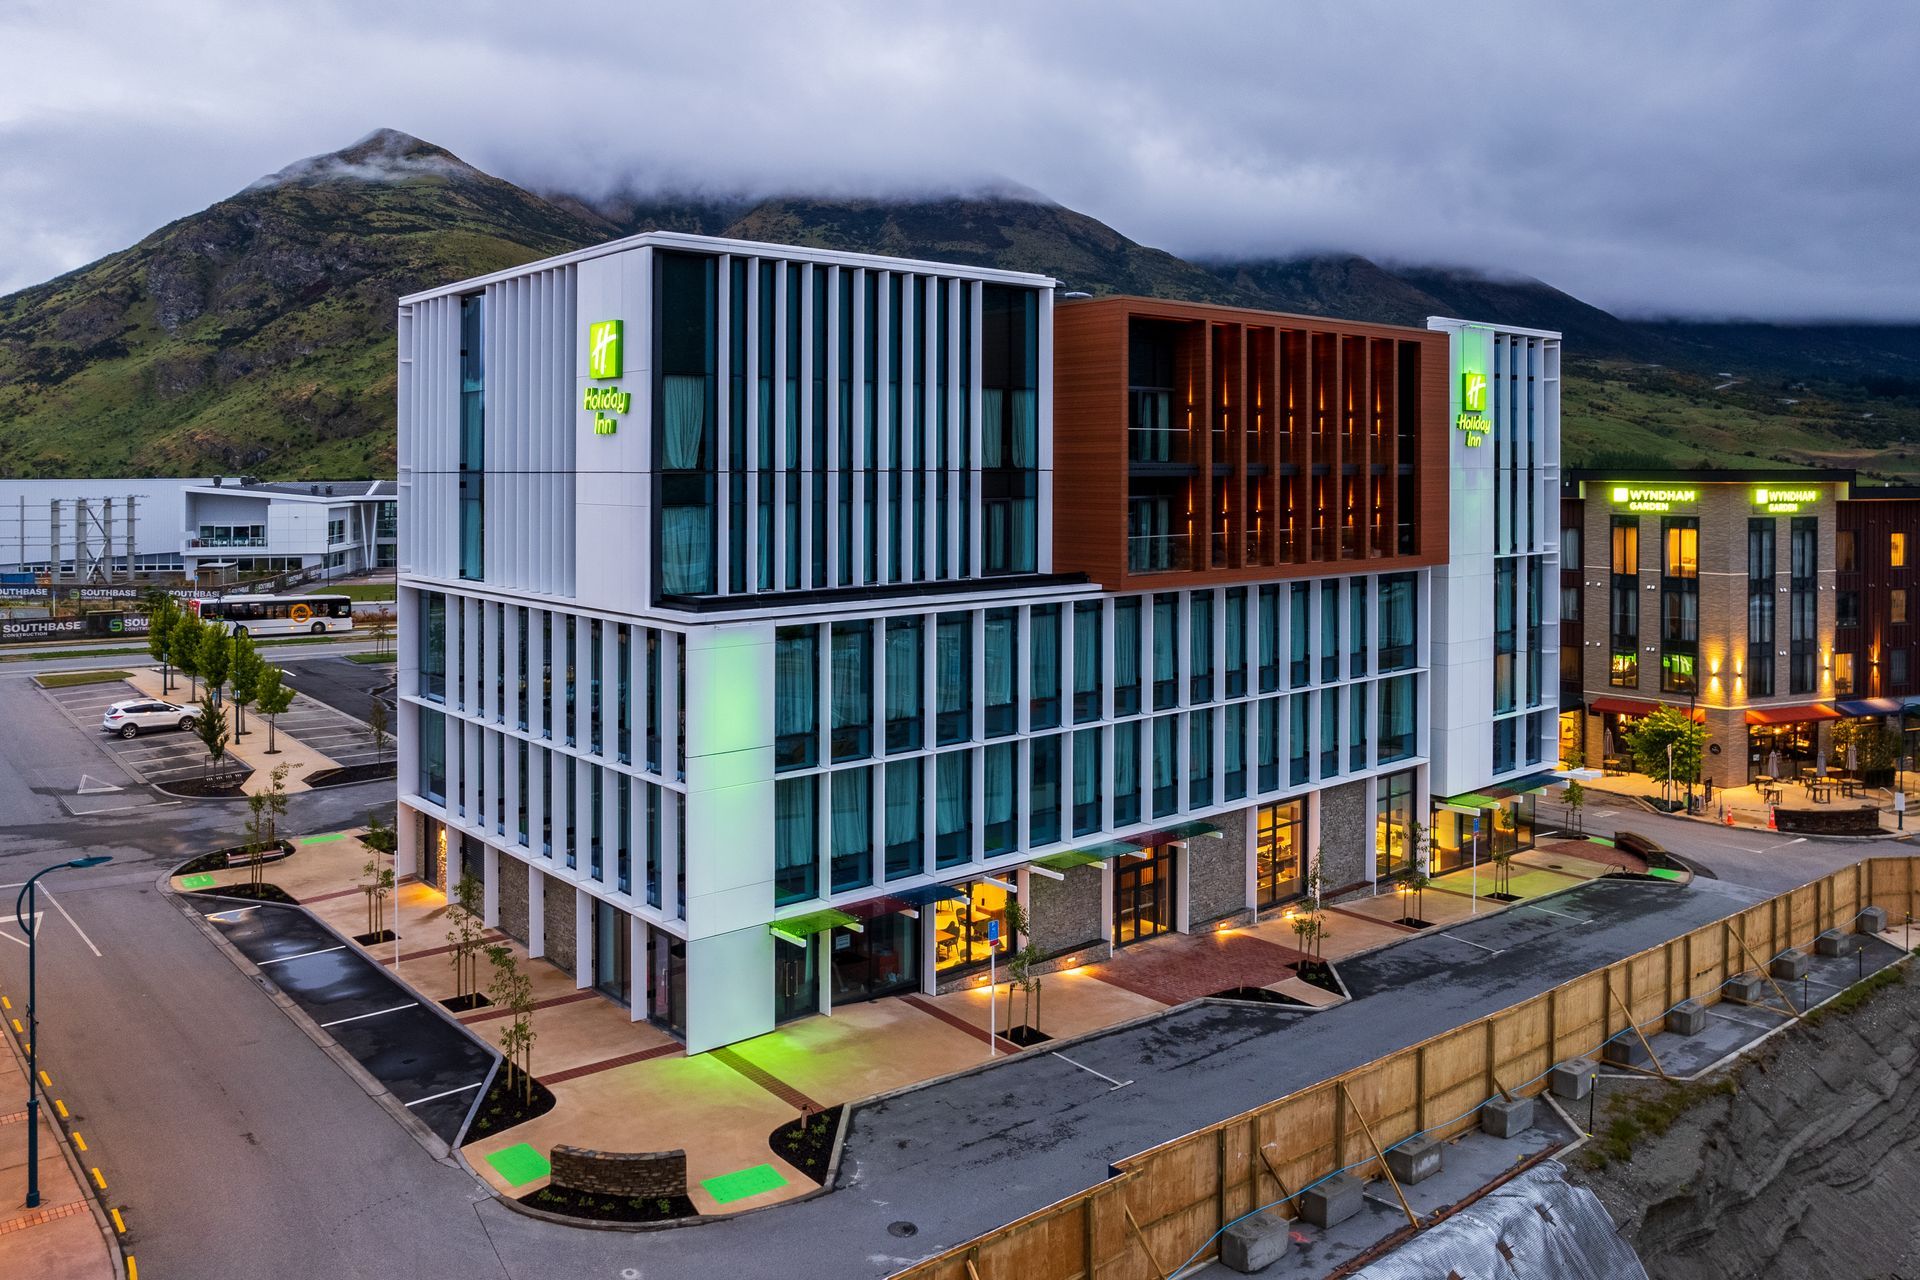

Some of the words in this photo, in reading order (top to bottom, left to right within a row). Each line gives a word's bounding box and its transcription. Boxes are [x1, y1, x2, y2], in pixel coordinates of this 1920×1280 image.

[584, 386, 629, 415] Holiday
[594, 412, 614, 435] Inn
[1458, 413, 1491, 434] Holiday
[1467, 431, 1482, 447] Inn
[1629, 489, 1696, 502] WYNDHAM
[1768, 490, 1817, 502] WYNDHAM
[1629, 502, 1669, 511] GARDEN
[1768, 503, 1798, 512] GARDEN
[80, 589, 137, 597] SOUTHBASE
[2, 621, 81, 633] SOUTHBASE
